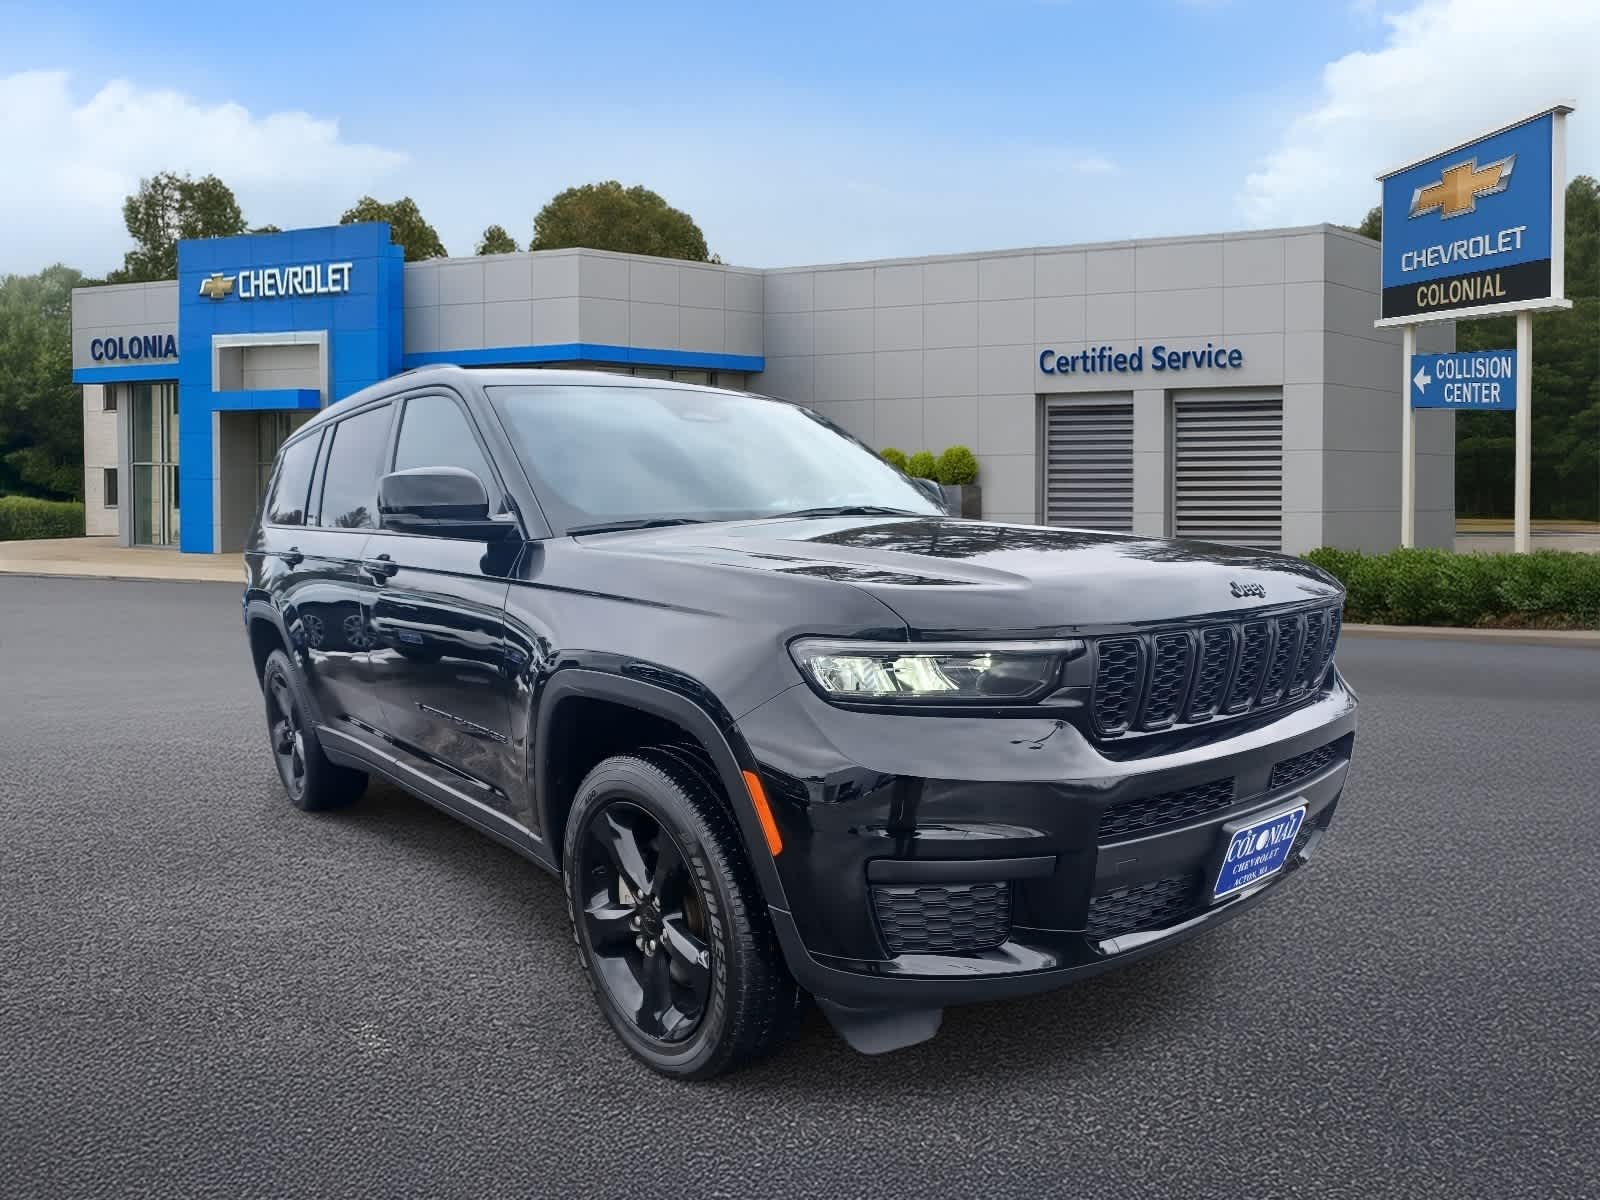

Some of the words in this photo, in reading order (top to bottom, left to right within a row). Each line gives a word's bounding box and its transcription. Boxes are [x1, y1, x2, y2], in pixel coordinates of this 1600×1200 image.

[1401, 225, 1527, 272] CHEVROLET
[238, 262, 352, 298] CHEVROLET
[1416, 273, 1506, 307] COLONIAL
[91, 334, 178, 360] COLONIA
[1039, 346, 1143, 375] Certified
[1151, 343, 1243, 371] Service
[1436, 357, 1512, 379] COLLISION
[1444, 383, 1501, 403] CENTER
[1233, 847, 1280, 875] CHEVROLET
